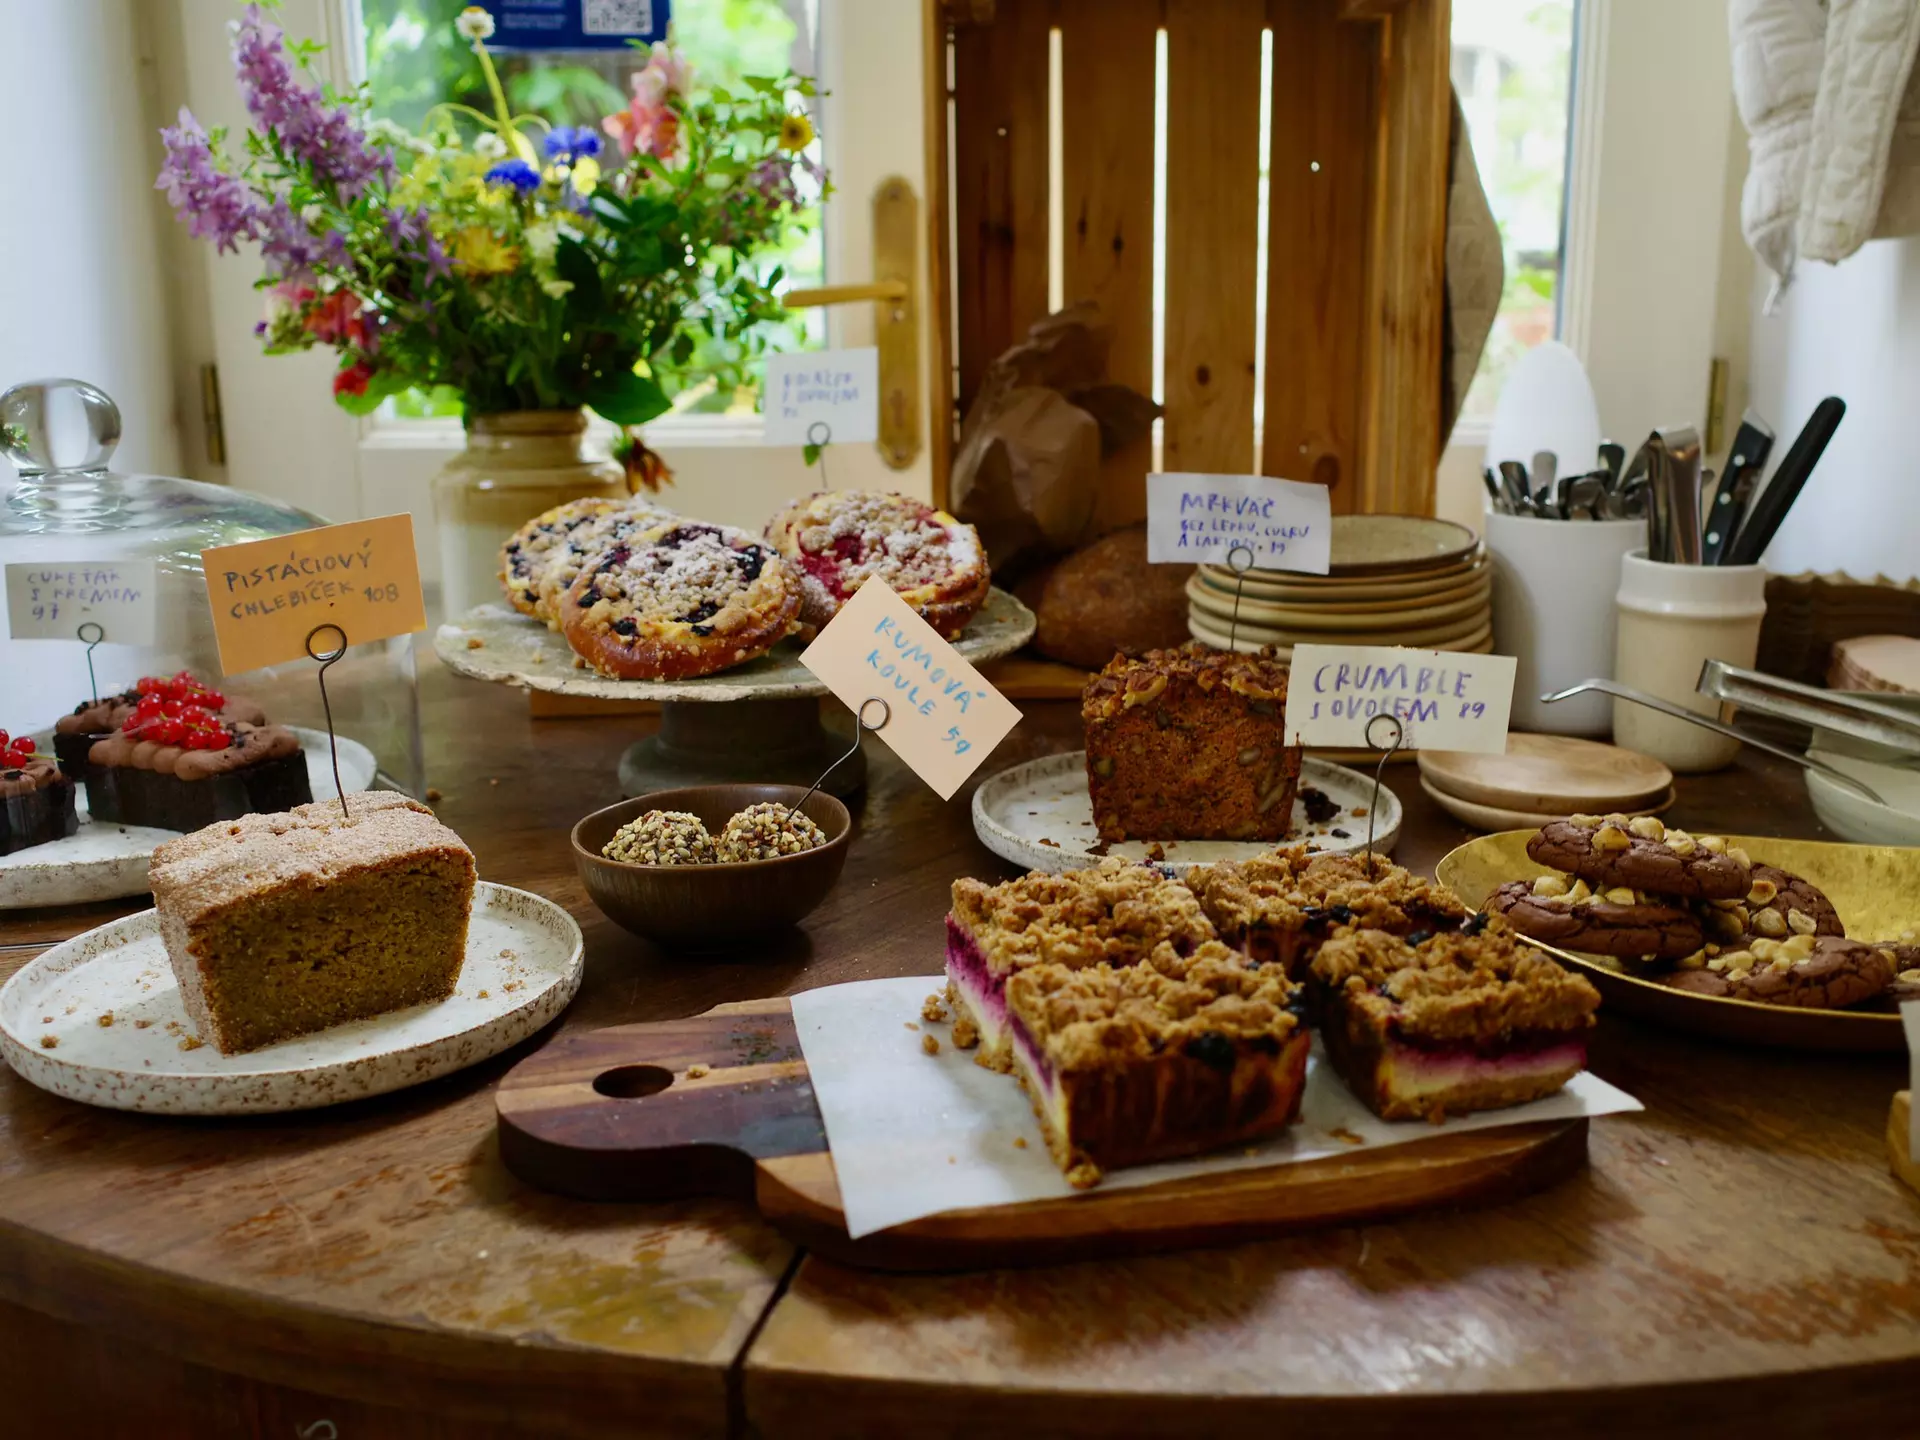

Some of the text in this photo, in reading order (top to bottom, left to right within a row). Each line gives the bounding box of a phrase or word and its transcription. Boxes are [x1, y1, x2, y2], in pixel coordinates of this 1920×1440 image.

[1178, 533, 1188, 548] A
[222, 538, 373, 592] PISTÁCIOVÝ
[363, 583, 399, 603] 108
[874, 615, 987, 714] RUMOVÁ
[1313, 663, 1473, 698] CRUMBLE
[865, 649, 937, 716] KOULE
[1331, 695, 1439, 722] OVOCEM
[1458, 702, 1486, 719] 89
